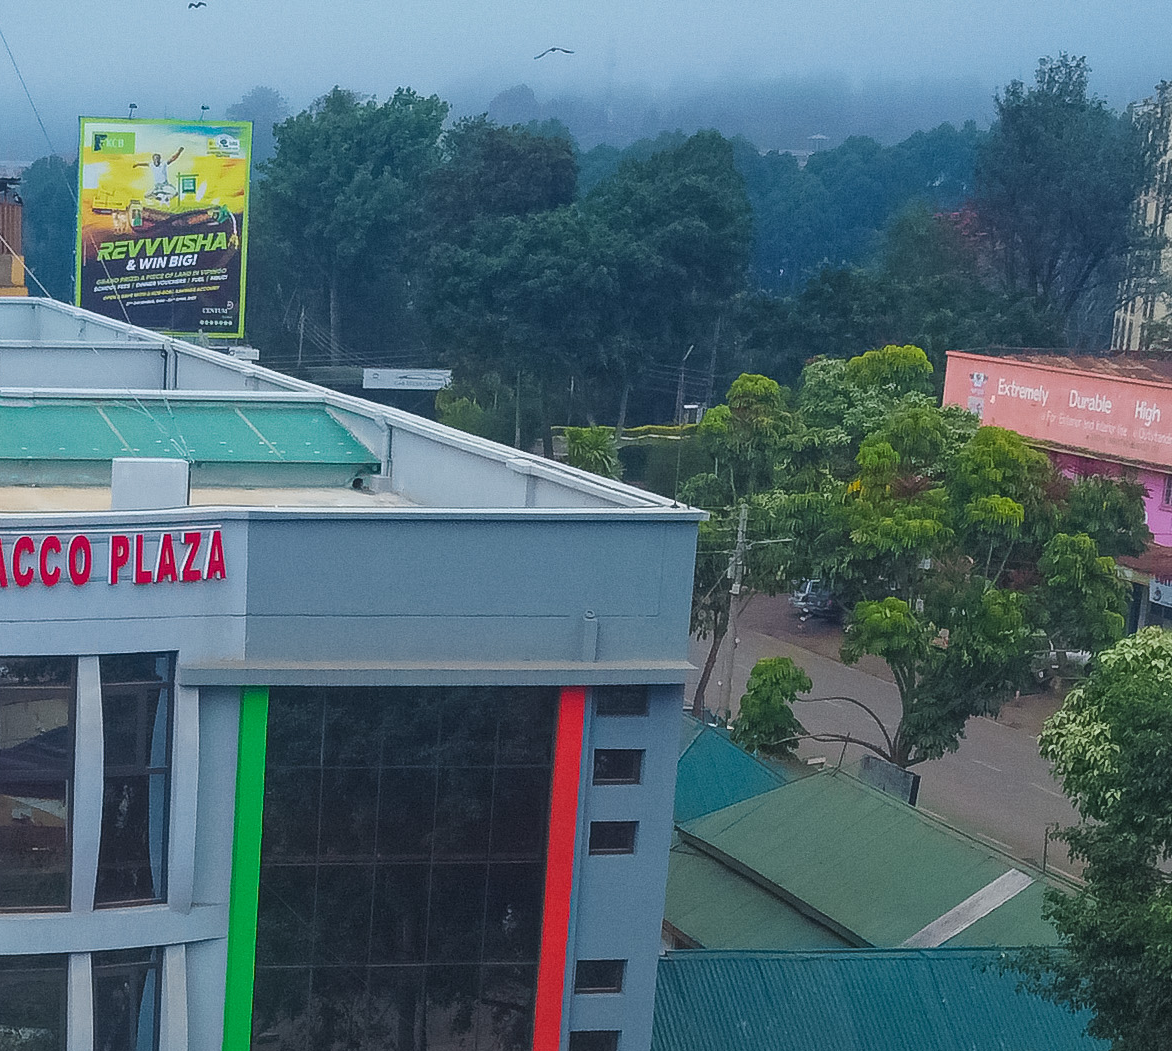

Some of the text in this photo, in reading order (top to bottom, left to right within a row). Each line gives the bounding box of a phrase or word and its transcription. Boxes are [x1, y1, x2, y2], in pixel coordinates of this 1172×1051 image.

[97, 232, 228, 260] REVVVISHA
[126, 254, 198, 271] & WIN BIG!
[997, 378, 1049, 407] Extremely
[1069, 389, 1112, 414] Durable
[1135, 400, 1161, 426] High
[107, 530, 227, 585] PLAZA
